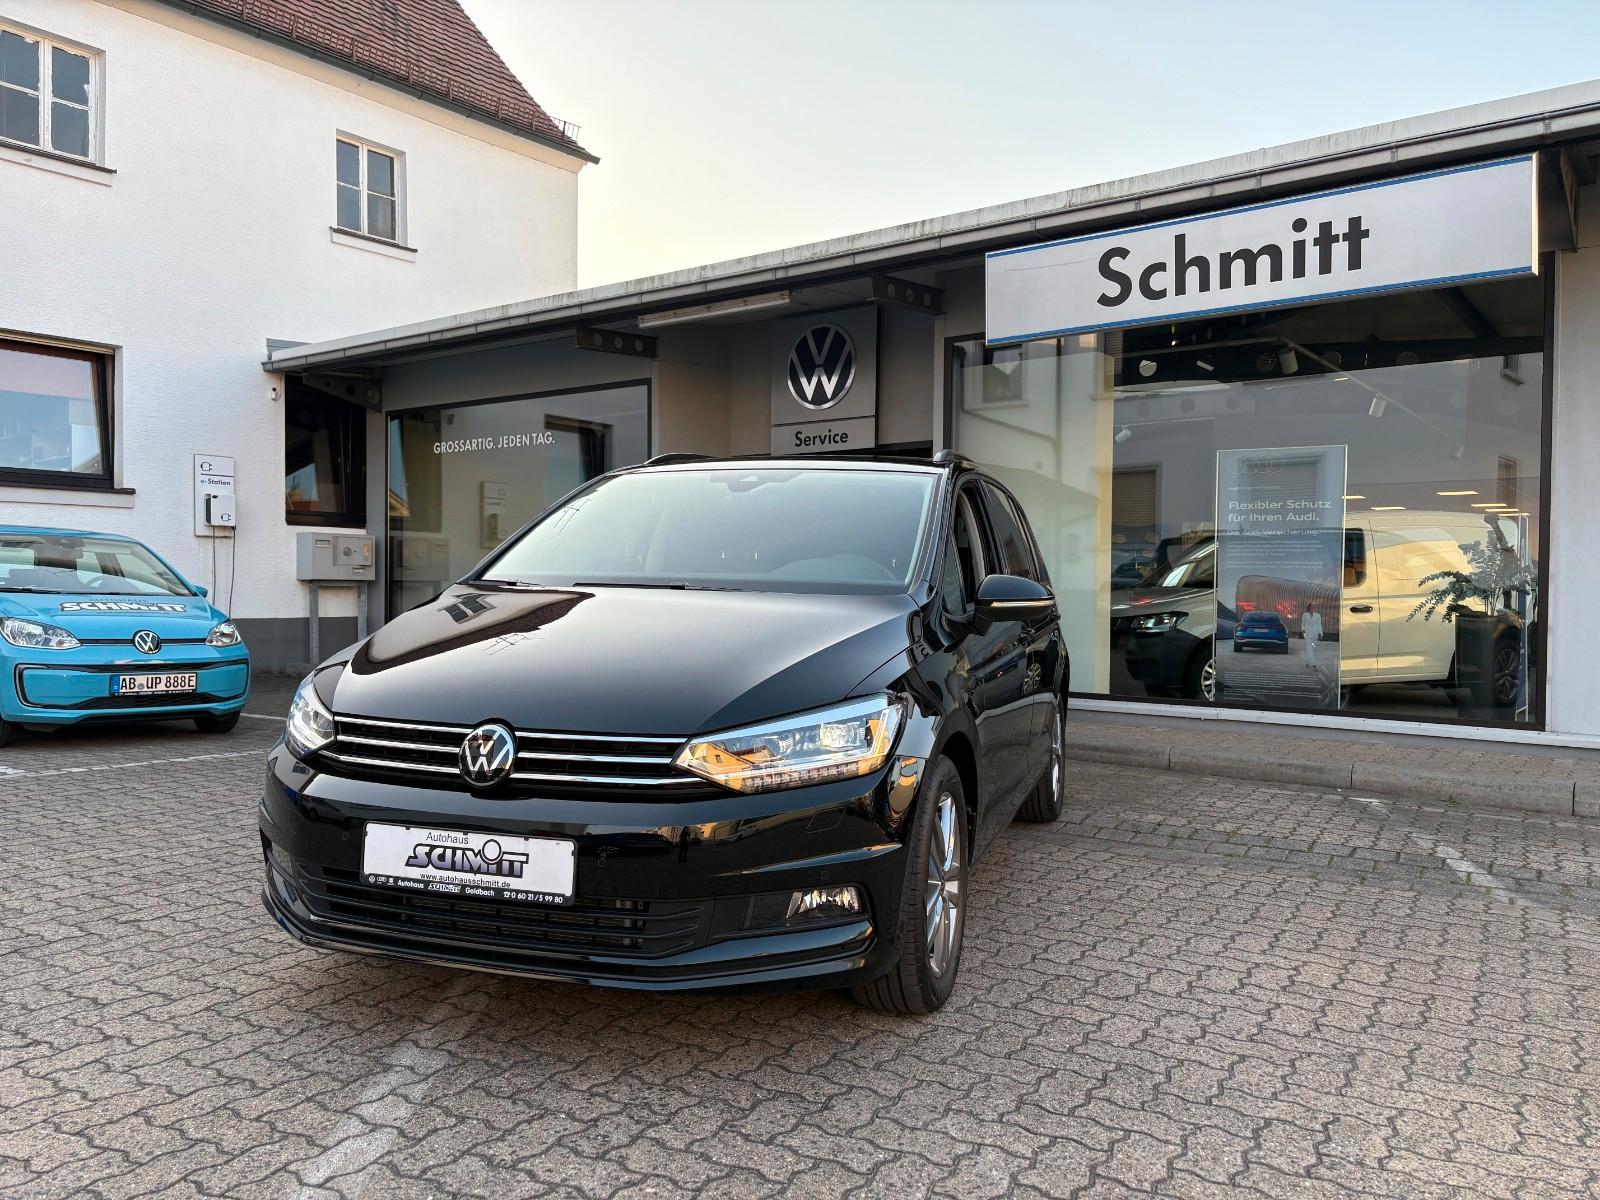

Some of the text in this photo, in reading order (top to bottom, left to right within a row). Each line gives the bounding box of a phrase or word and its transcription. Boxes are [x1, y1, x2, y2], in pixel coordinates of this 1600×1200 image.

[1097, 216, 1370, 308] Schmitt
[433, 431, 556, 454] GROSSARTIG. JEDEN TAG.
[794, 429, 849, 447] Service
[1228, 499, 1332, 510] Flexibler Schutz
[1228, 511, 1320, 523] für Ihren Audi.
[120, 675, 195, 691] AB UP 888E
[426, 831, 470, 846] Autohaus
[419, 872, 511, 889] www.autohausschmitt.de
[397, 879, 425, 889] Autohaus
[465, 887, 495, 897] Goldbach
[517, 892, 527, 900] 60
